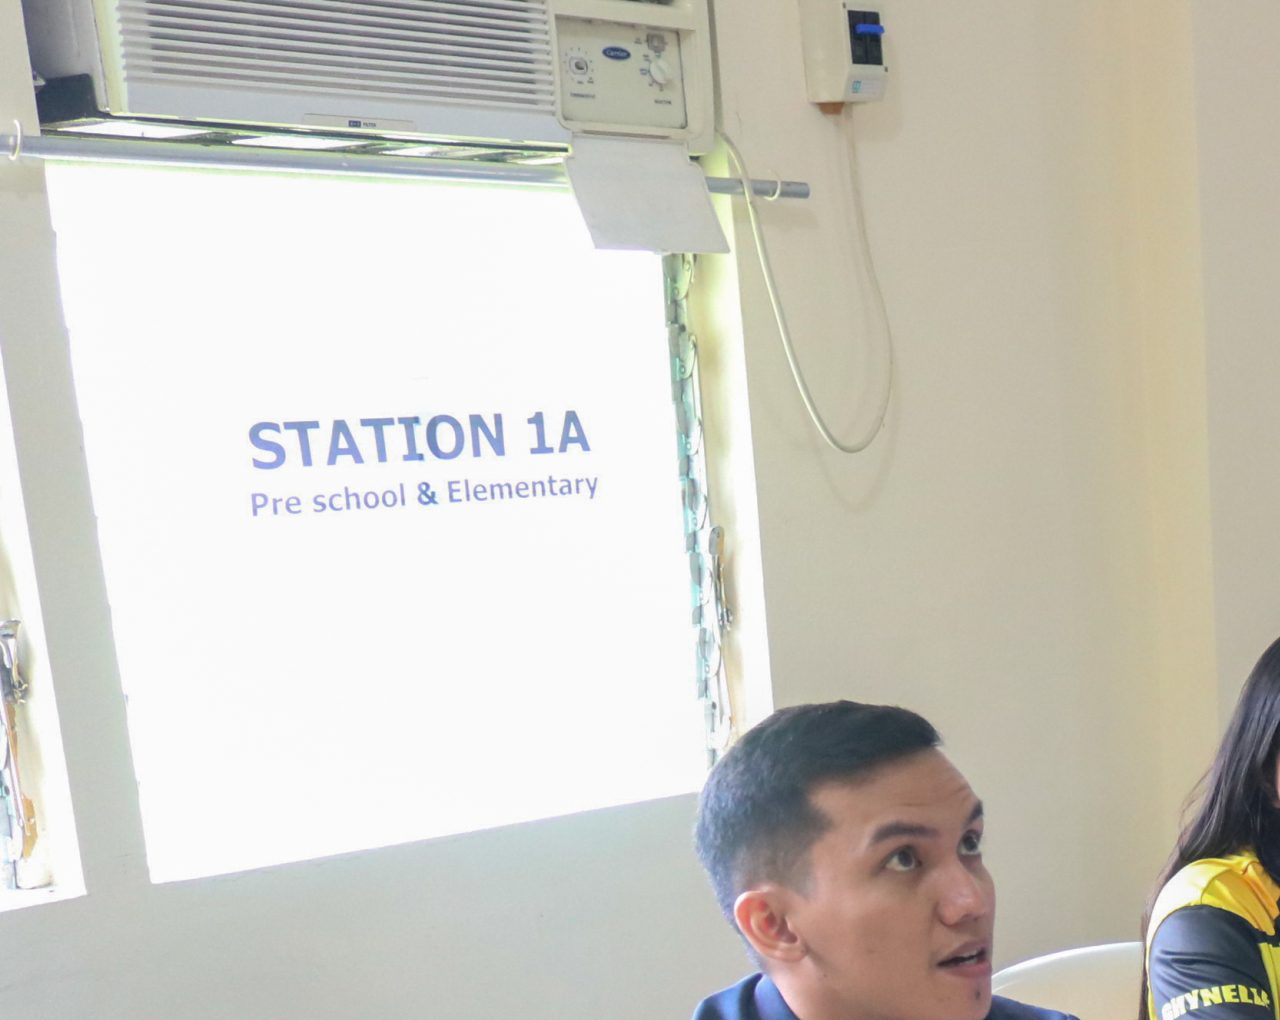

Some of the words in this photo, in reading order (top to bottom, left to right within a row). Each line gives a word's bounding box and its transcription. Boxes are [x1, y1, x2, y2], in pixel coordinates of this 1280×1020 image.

[248, 413, 506, 470] STATION
[527, 410, 591, 454] 1A
[251, 492, 302, 517] Pre
[313, 483, 406, 513] school
[417, 481, 439, 506] &
[448, 474, 598, 503] Elementary
